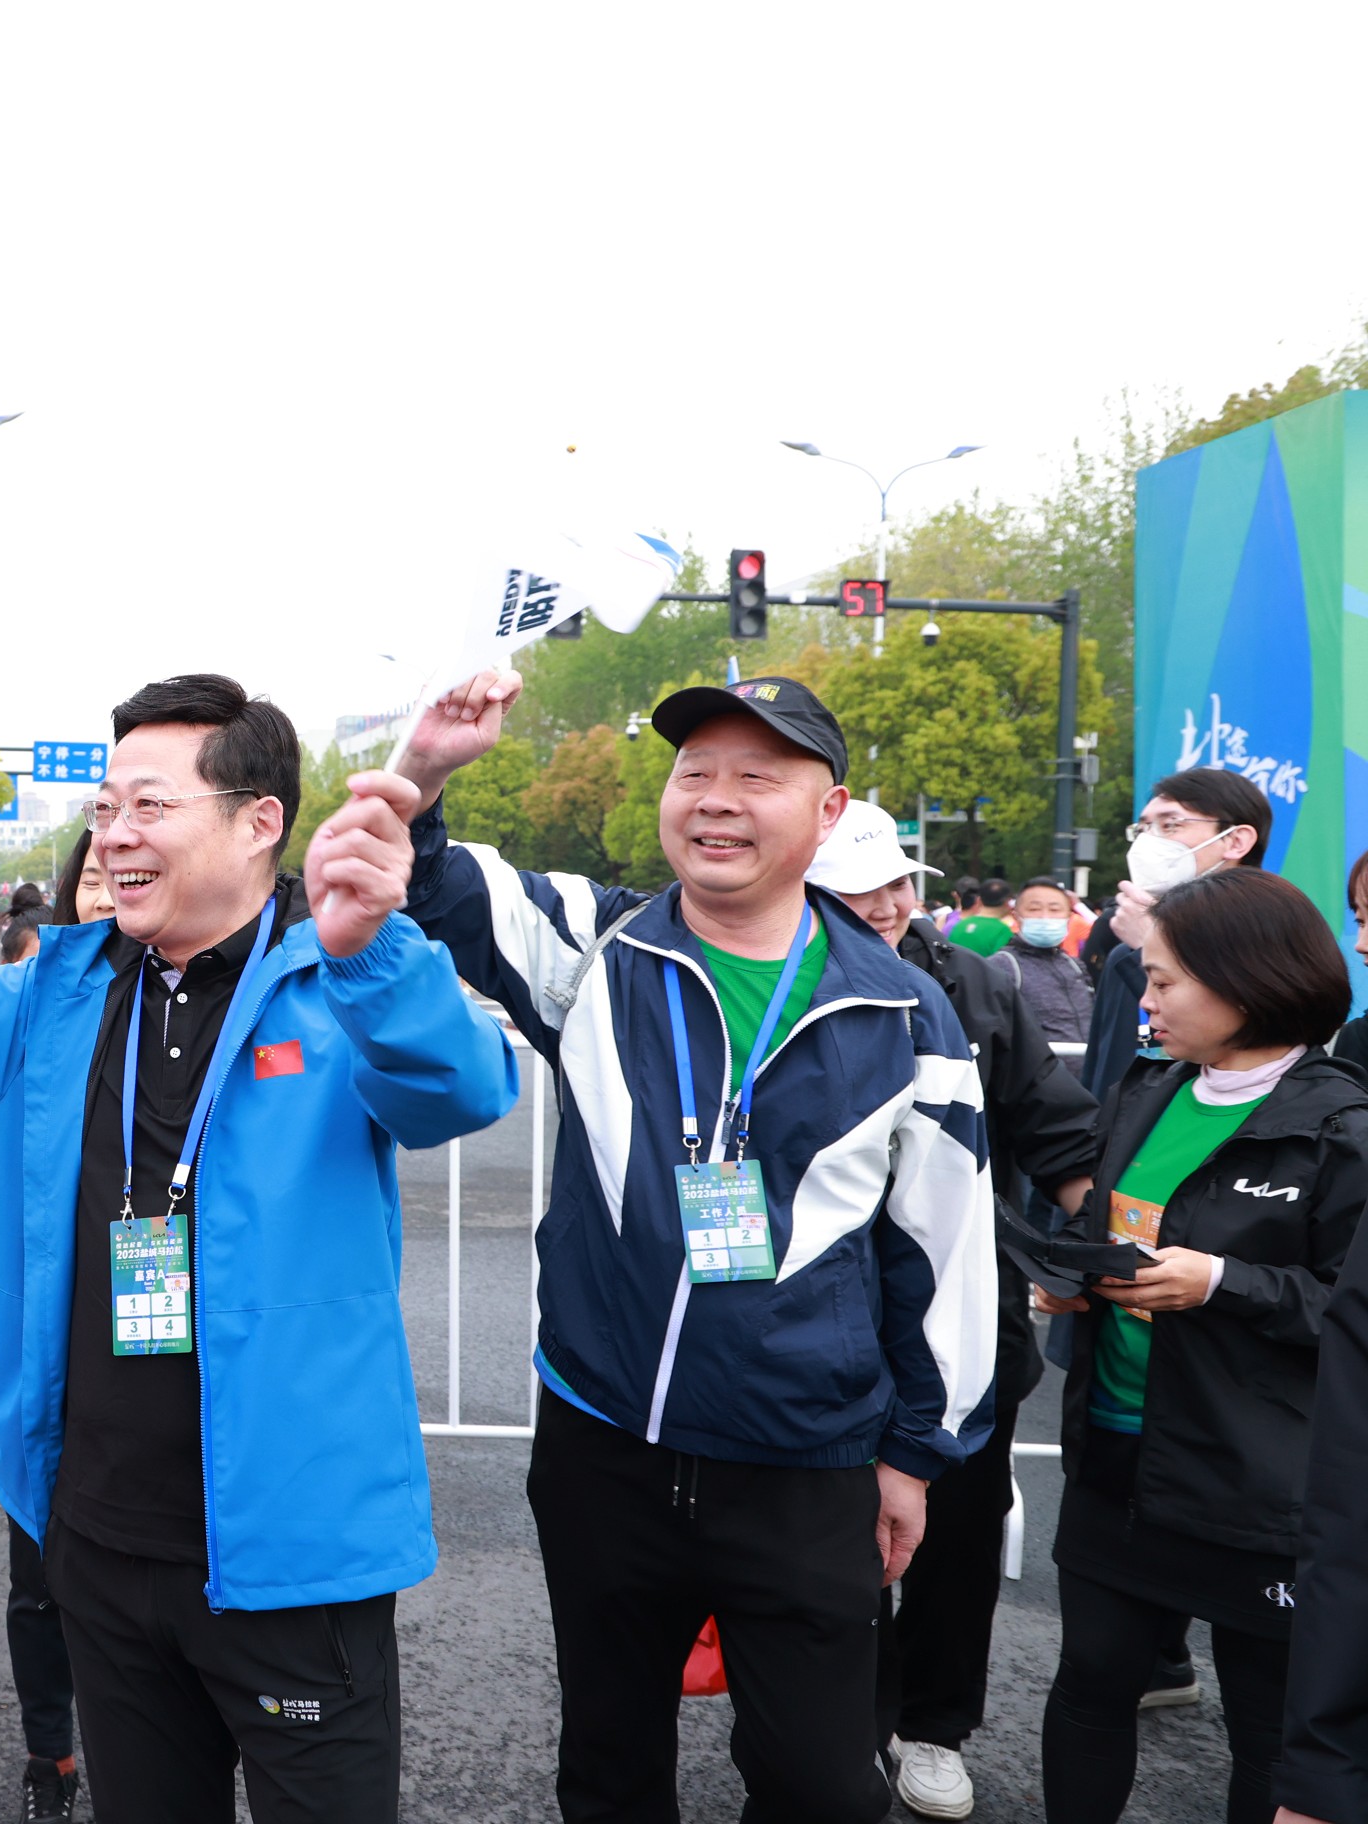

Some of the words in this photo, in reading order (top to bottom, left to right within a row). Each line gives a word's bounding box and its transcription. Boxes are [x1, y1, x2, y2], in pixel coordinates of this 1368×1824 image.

[843, 581, 885, 616] 57
[37, 745, 104, 762] 宁停一分
[36, 764, 104, 780] 不抢一秒
[683, 1186, 758, 1200] 2023盐城马拉松
[699, 1206, 747, 1219] 工作人员
[703, 1232, 710, 1243] 1
[742, 1229, 751, 1240] 2
[116, 1245, 184, 1260] 2023盐城马拉松
[706, 1252, 715, 1264] 3
[129, 1297, 136, 1309] 1
[164, 1295, 173, 1308] 2
[130, 1321, 138, 1333] 3
[164, 1319, 174, 1332] 4
